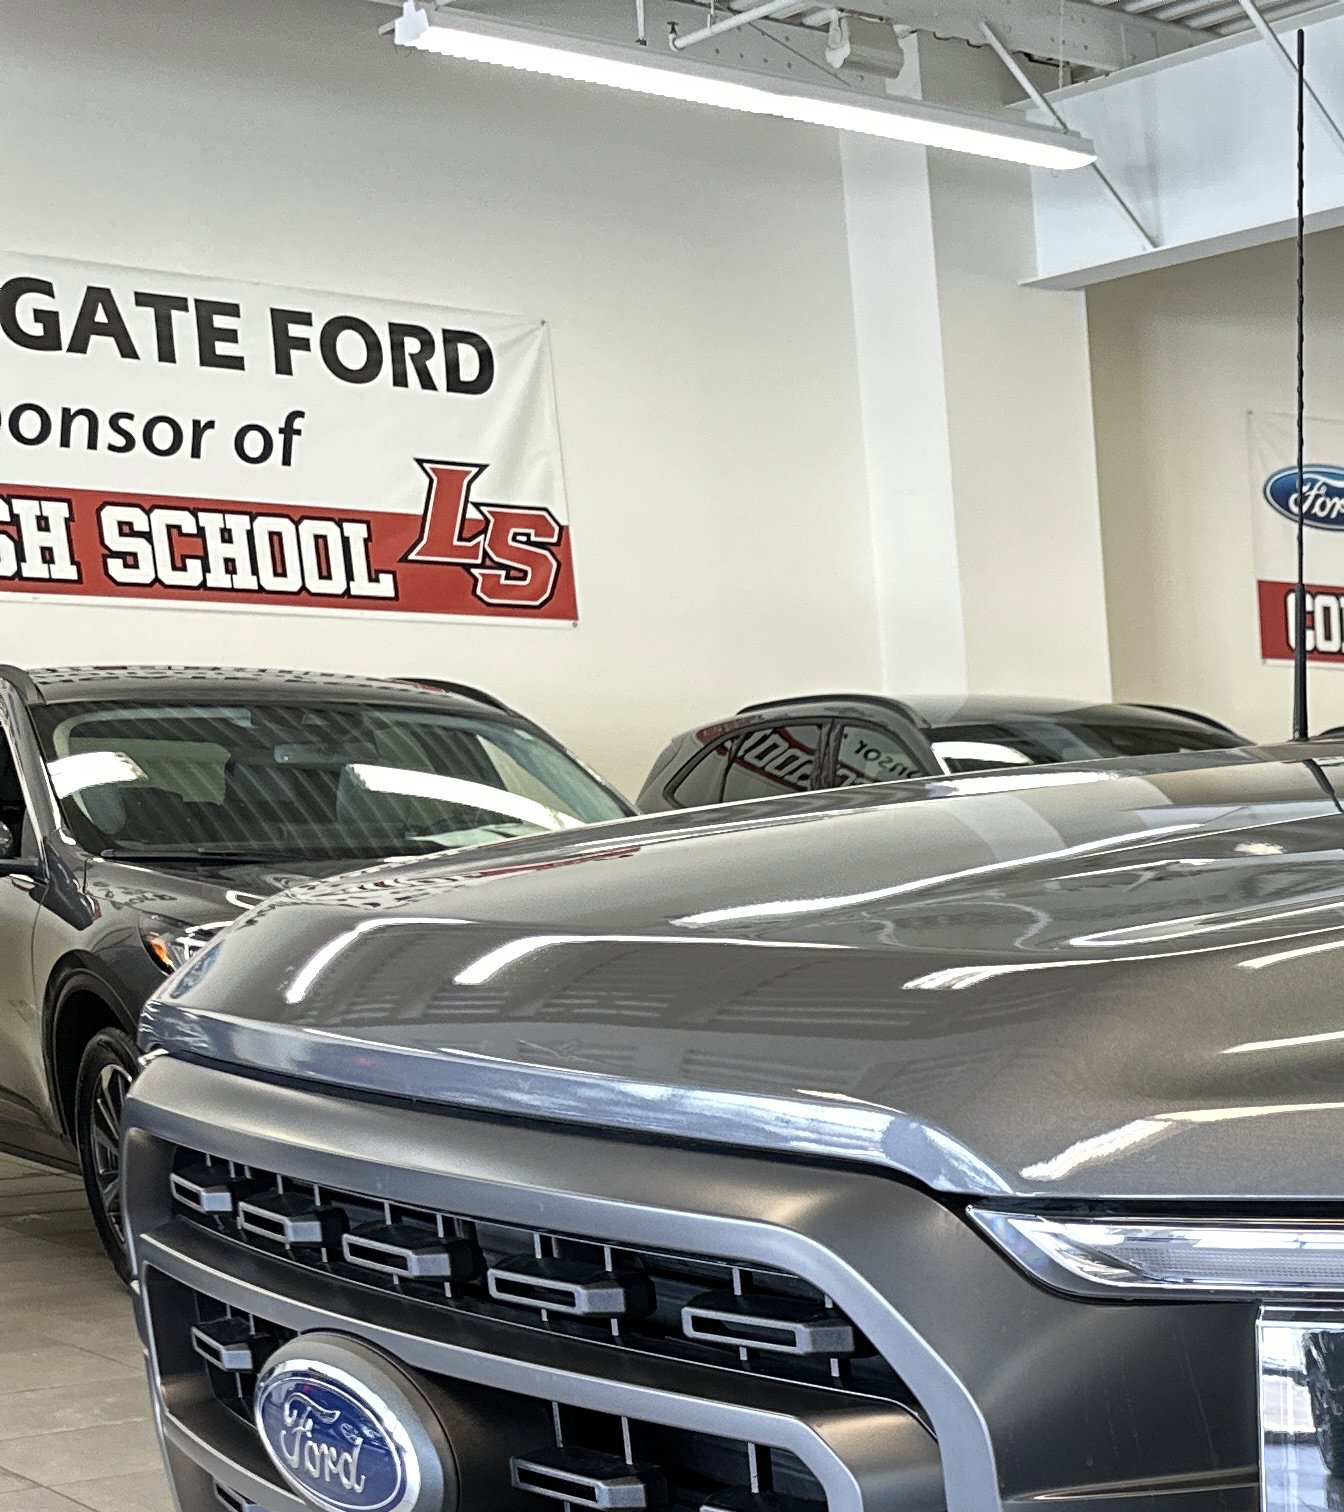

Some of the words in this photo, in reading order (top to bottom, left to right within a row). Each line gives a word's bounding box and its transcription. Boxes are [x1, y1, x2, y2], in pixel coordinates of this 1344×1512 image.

[0, 276, 245, 372] GATE
[269, 306, 496, 397] FORD
[8, 402, 215, 460] onsor
[233, 409, 306, 467] of
[95, 500, 400, 602] SCHOOL
[397, 456, 564, 610] LS
[280, 1391, 366, 1494] Ford
